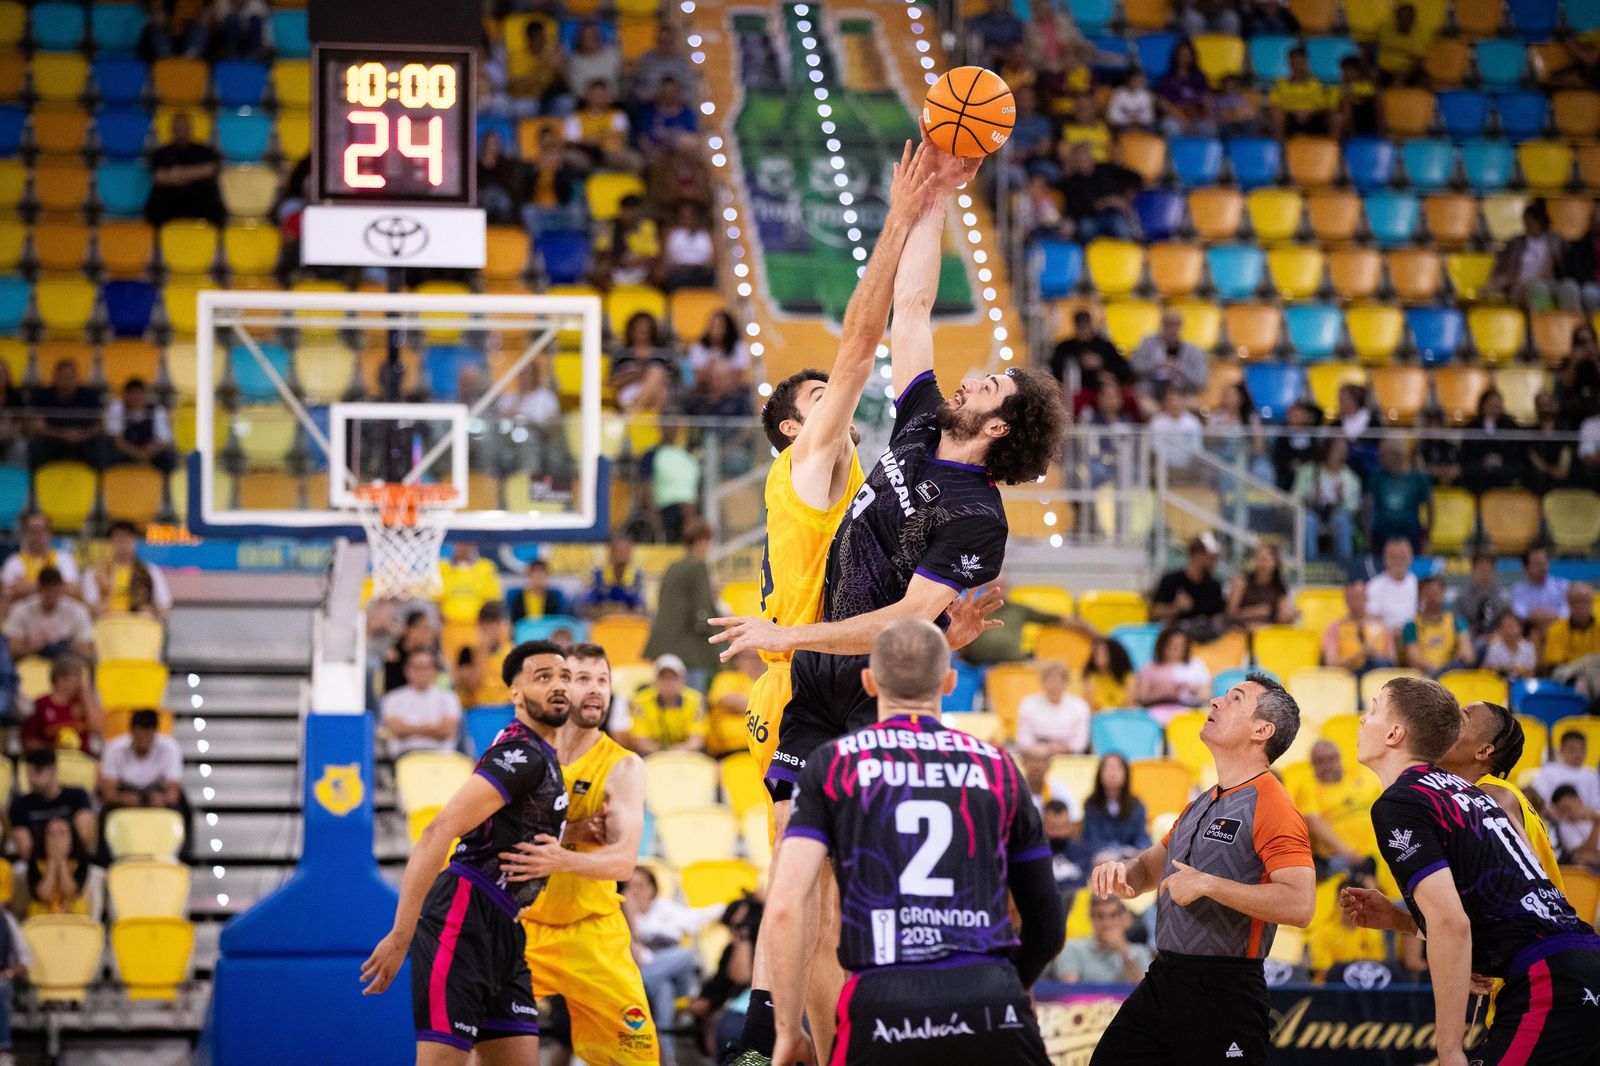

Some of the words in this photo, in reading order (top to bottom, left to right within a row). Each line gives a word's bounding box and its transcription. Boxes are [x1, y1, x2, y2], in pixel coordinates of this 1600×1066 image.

[346, 62, 456, 109] 10:00
[344, 111, 443, 188] 24
[772, 751, 799, 766] sisa
[836, 729, 1001, 760] ROUSSELLE
[857, 759, 989, 790] PULEVA
[895, 800, 954, 896] 2
[1206, 829, 1233, 840] endesa
[900, 906, 990, 928] GRANADA
[901, 926, 943, 945] 2031
[872, 1012, 976, 1043] Andalucía
